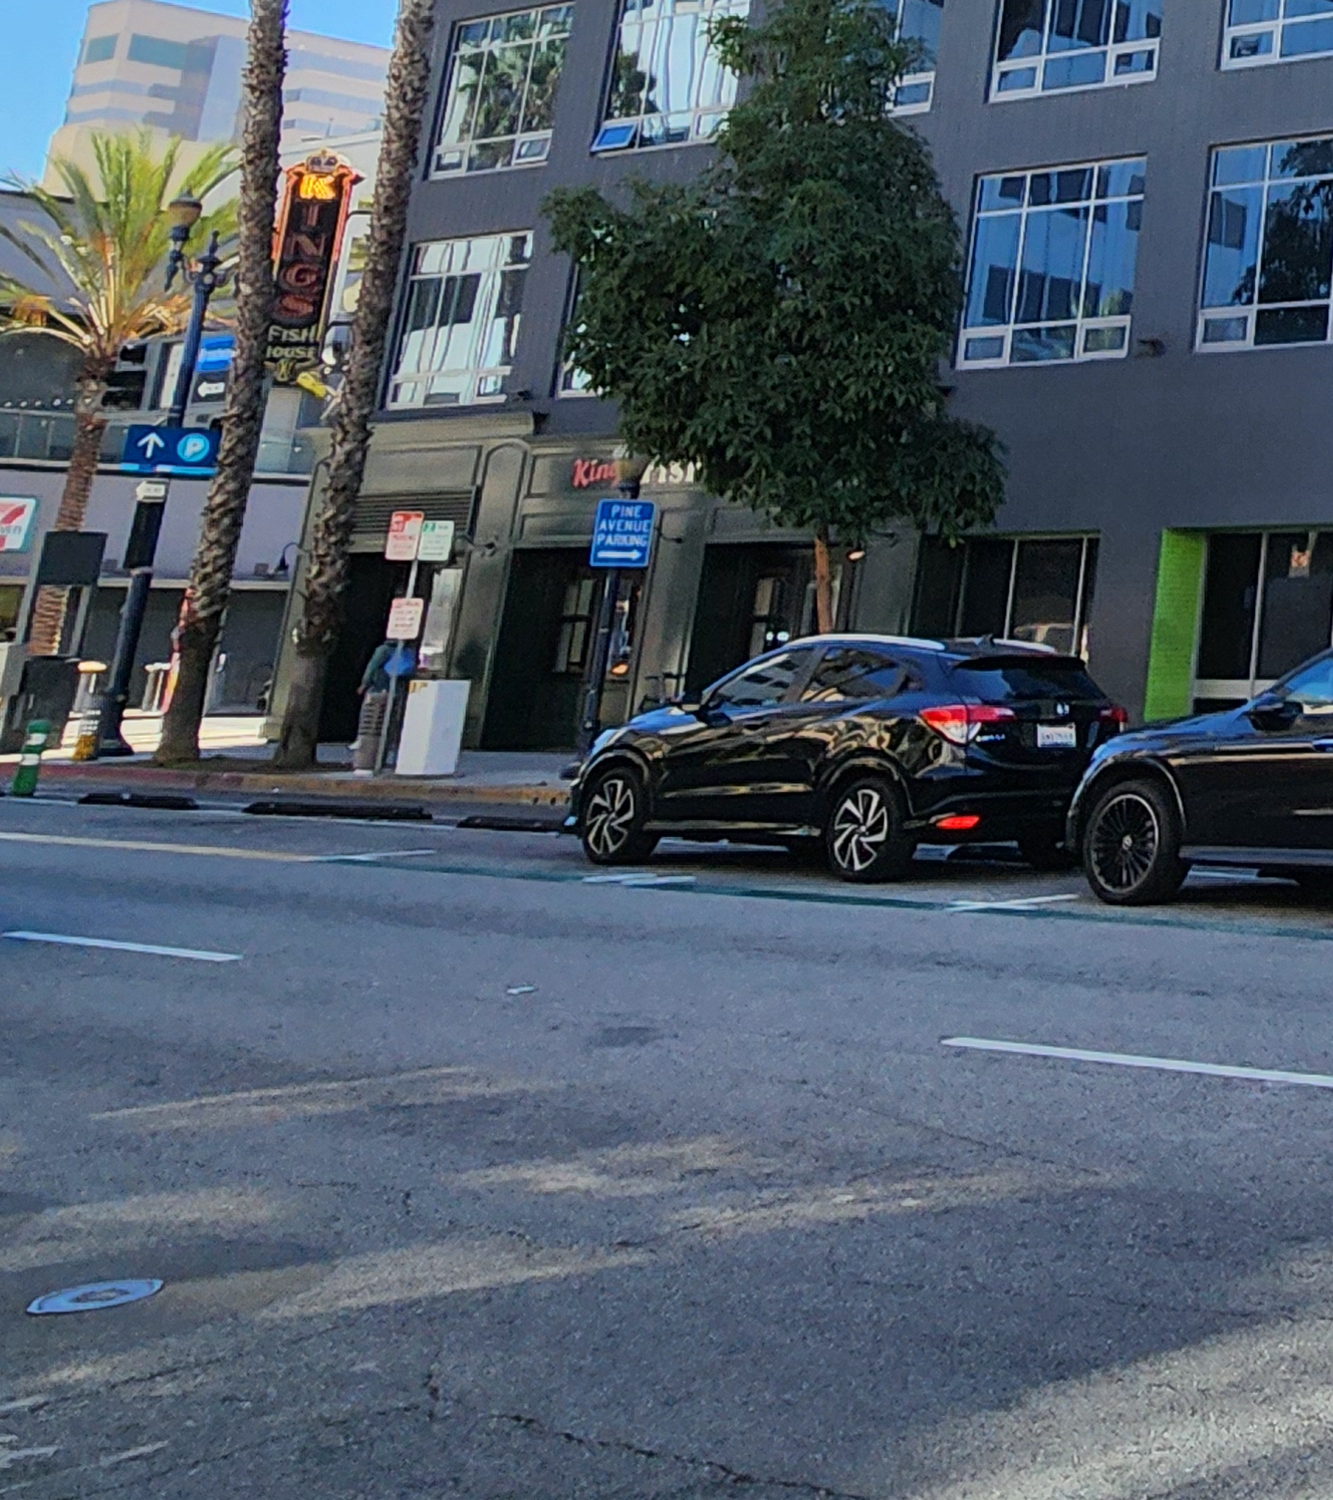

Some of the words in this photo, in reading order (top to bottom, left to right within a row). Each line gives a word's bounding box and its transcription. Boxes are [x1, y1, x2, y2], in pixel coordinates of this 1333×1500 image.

[280, 174, 336, 319] KINGS
[267, 324, 317, 342] FISH
[611, 504, 643, 518] PINE
[599, 518, 651, 533] AVENUE
[596, 533, 649, 547] PARKING
